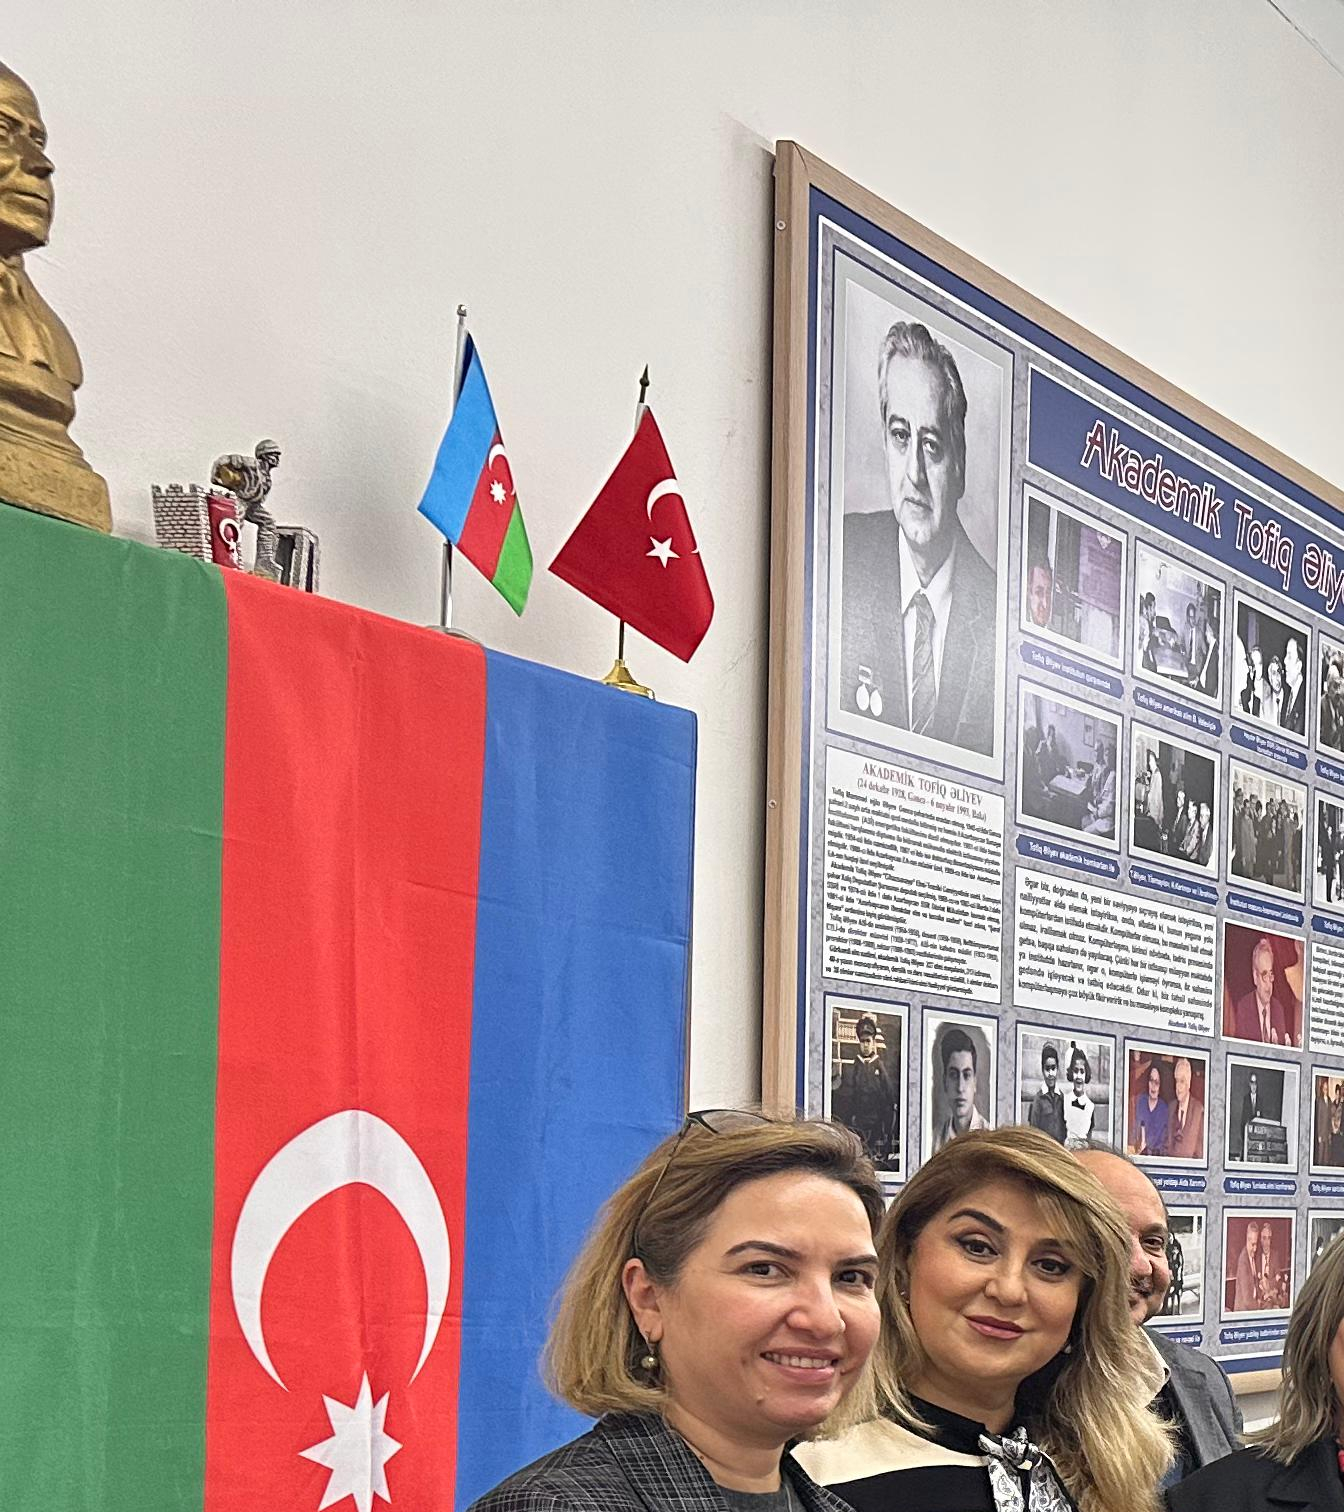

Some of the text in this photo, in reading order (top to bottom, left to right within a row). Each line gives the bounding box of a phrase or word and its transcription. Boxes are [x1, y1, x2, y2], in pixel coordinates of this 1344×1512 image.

[1080, 418, 1222, 539] Akademik
[1233, 502, 1295, 591] Tofiq
[862, 759, 914, 787] AKADEMİK
[918, 775, 946, 799] TOFİQ
